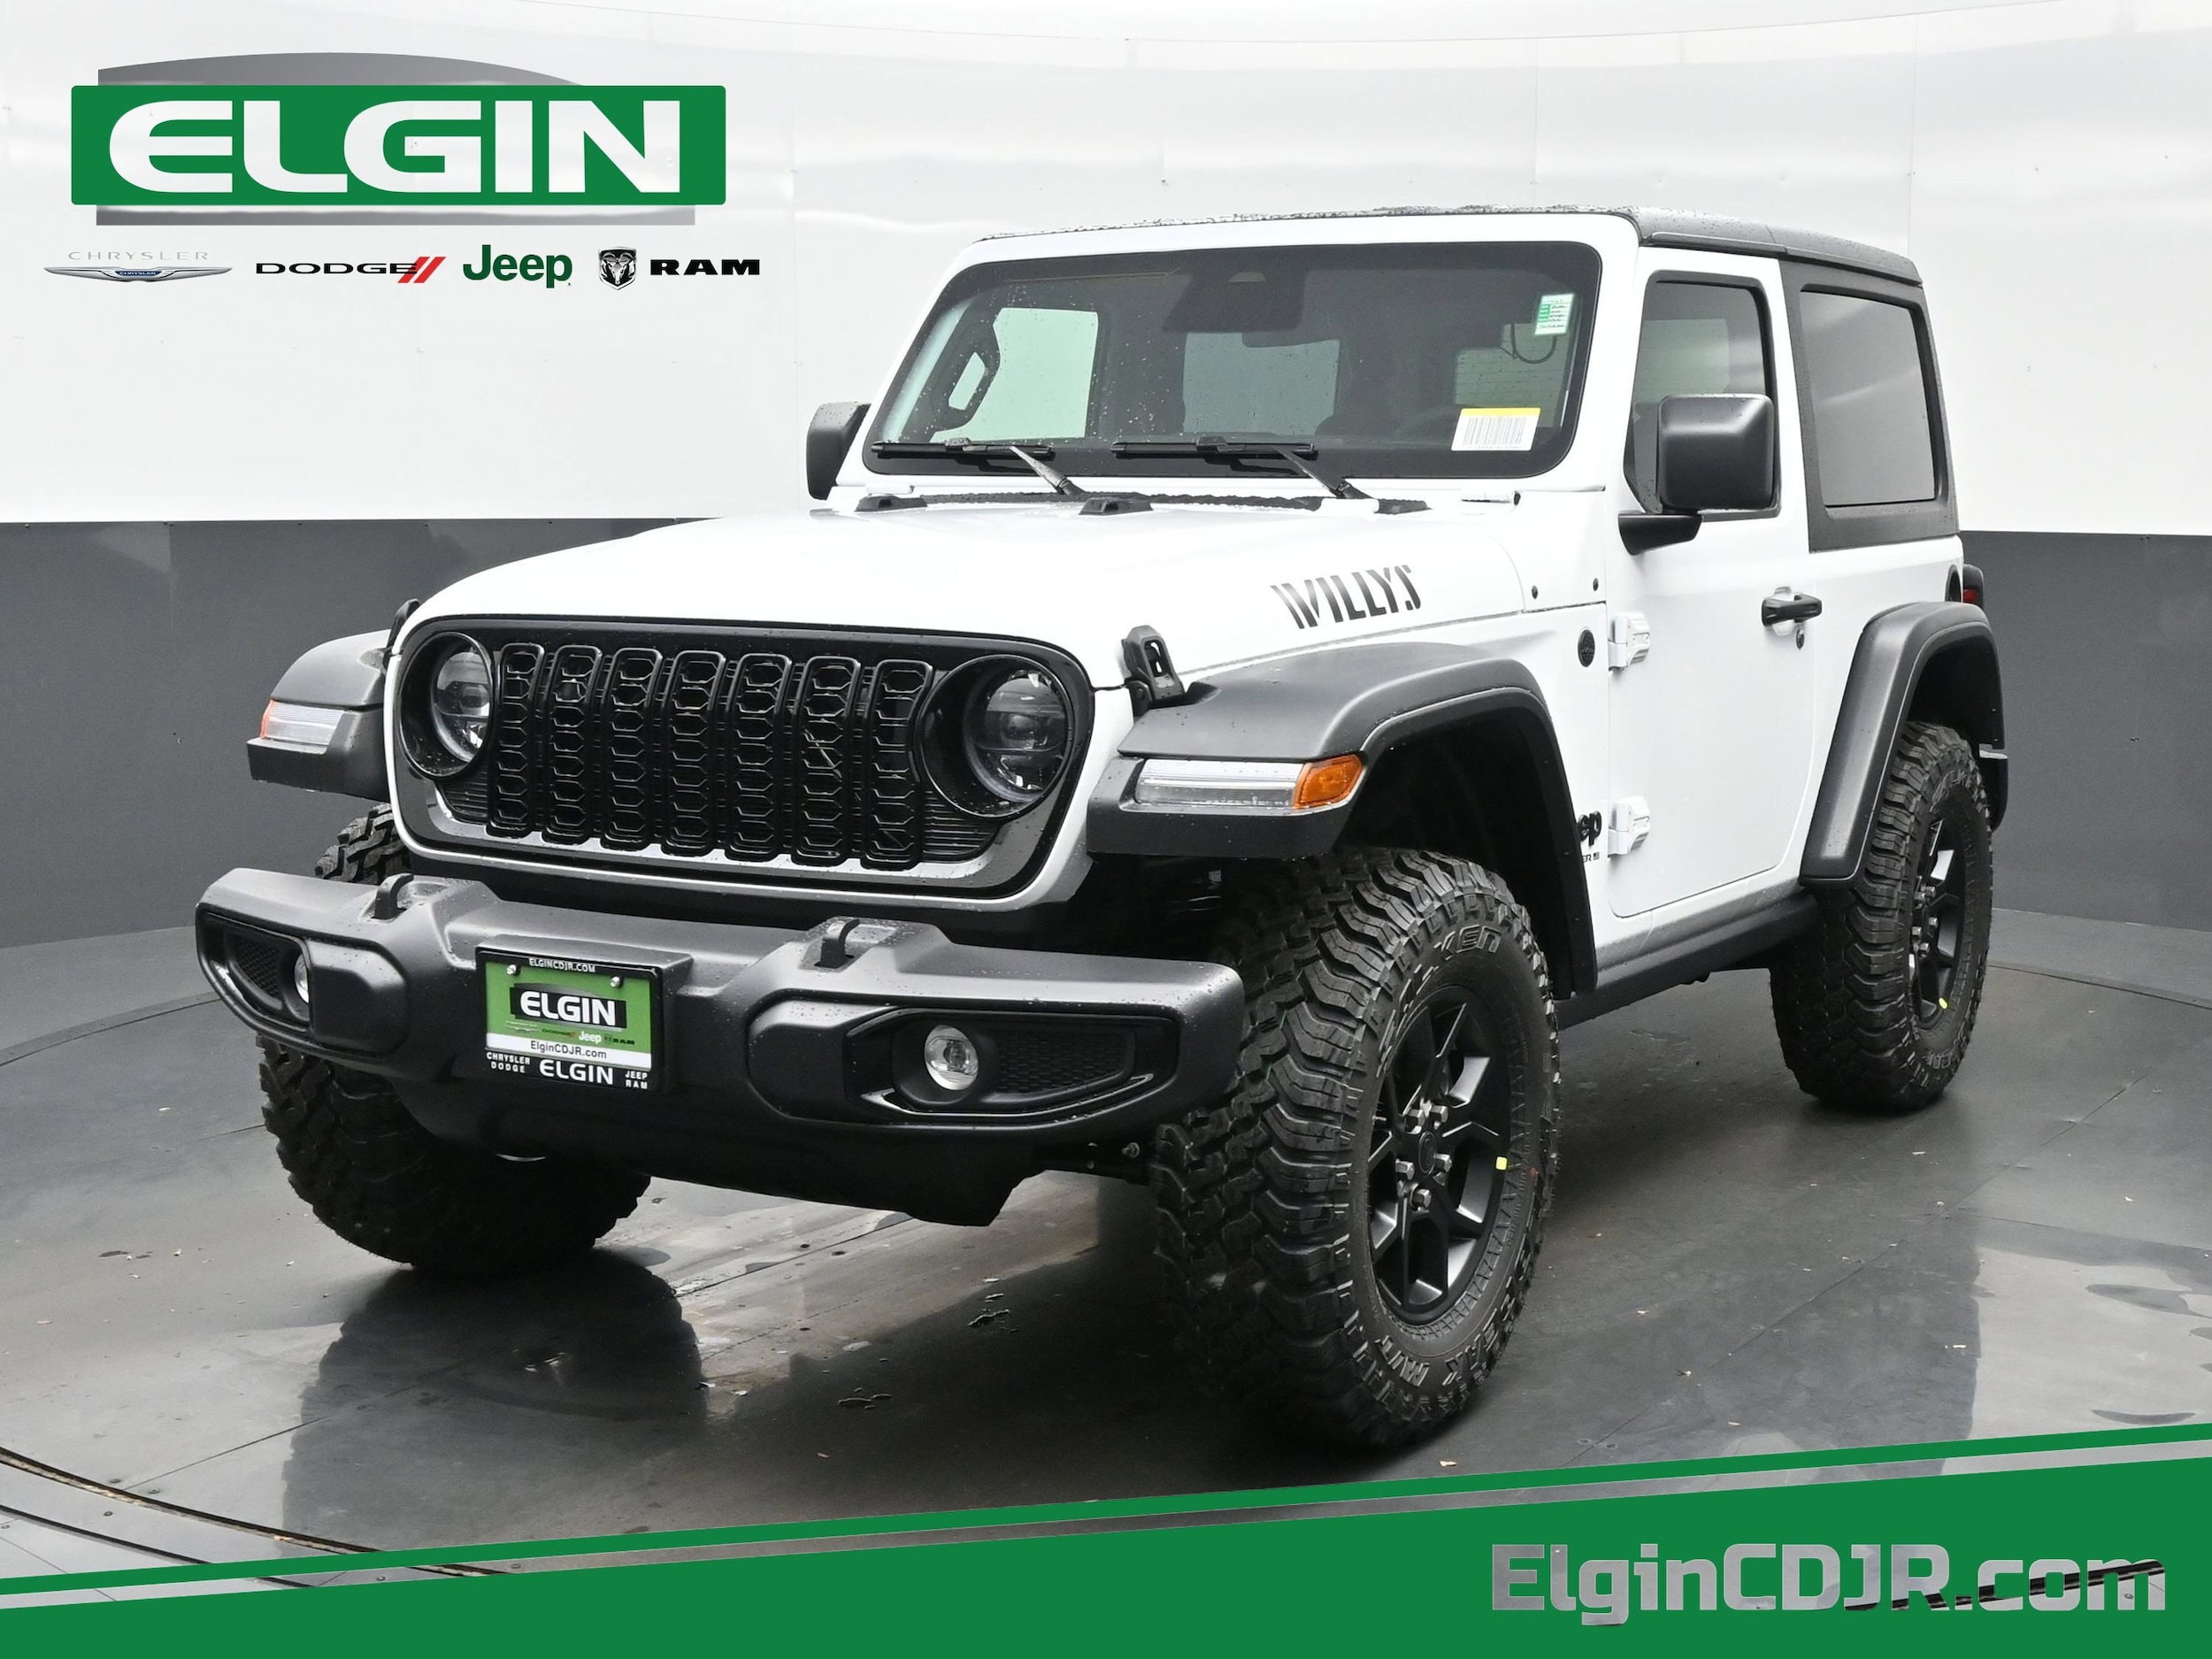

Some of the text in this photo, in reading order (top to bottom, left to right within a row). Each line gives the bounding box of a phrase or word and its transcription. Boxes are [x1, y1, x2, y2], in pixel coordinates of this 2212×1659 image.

[1270, 565, 1421, 629] WILLYS
[529, 958, 595, 972] ELGINCDJR.COM
[519, 990, 616, 1026] ELGIN
[579, 1031, 603, 1044] Jeep
[531, 1041, 607, 1059] ElginCDJR.com
[487, 1052, 530, 1065] CHRYSLER
[491, 1062, 526, 1073] DODGE
[539, 1059, 613, 1085] ELGIN
[625, 1071, 648, 1079] JEEP
[626, 1079, 648, 1089] RAM
